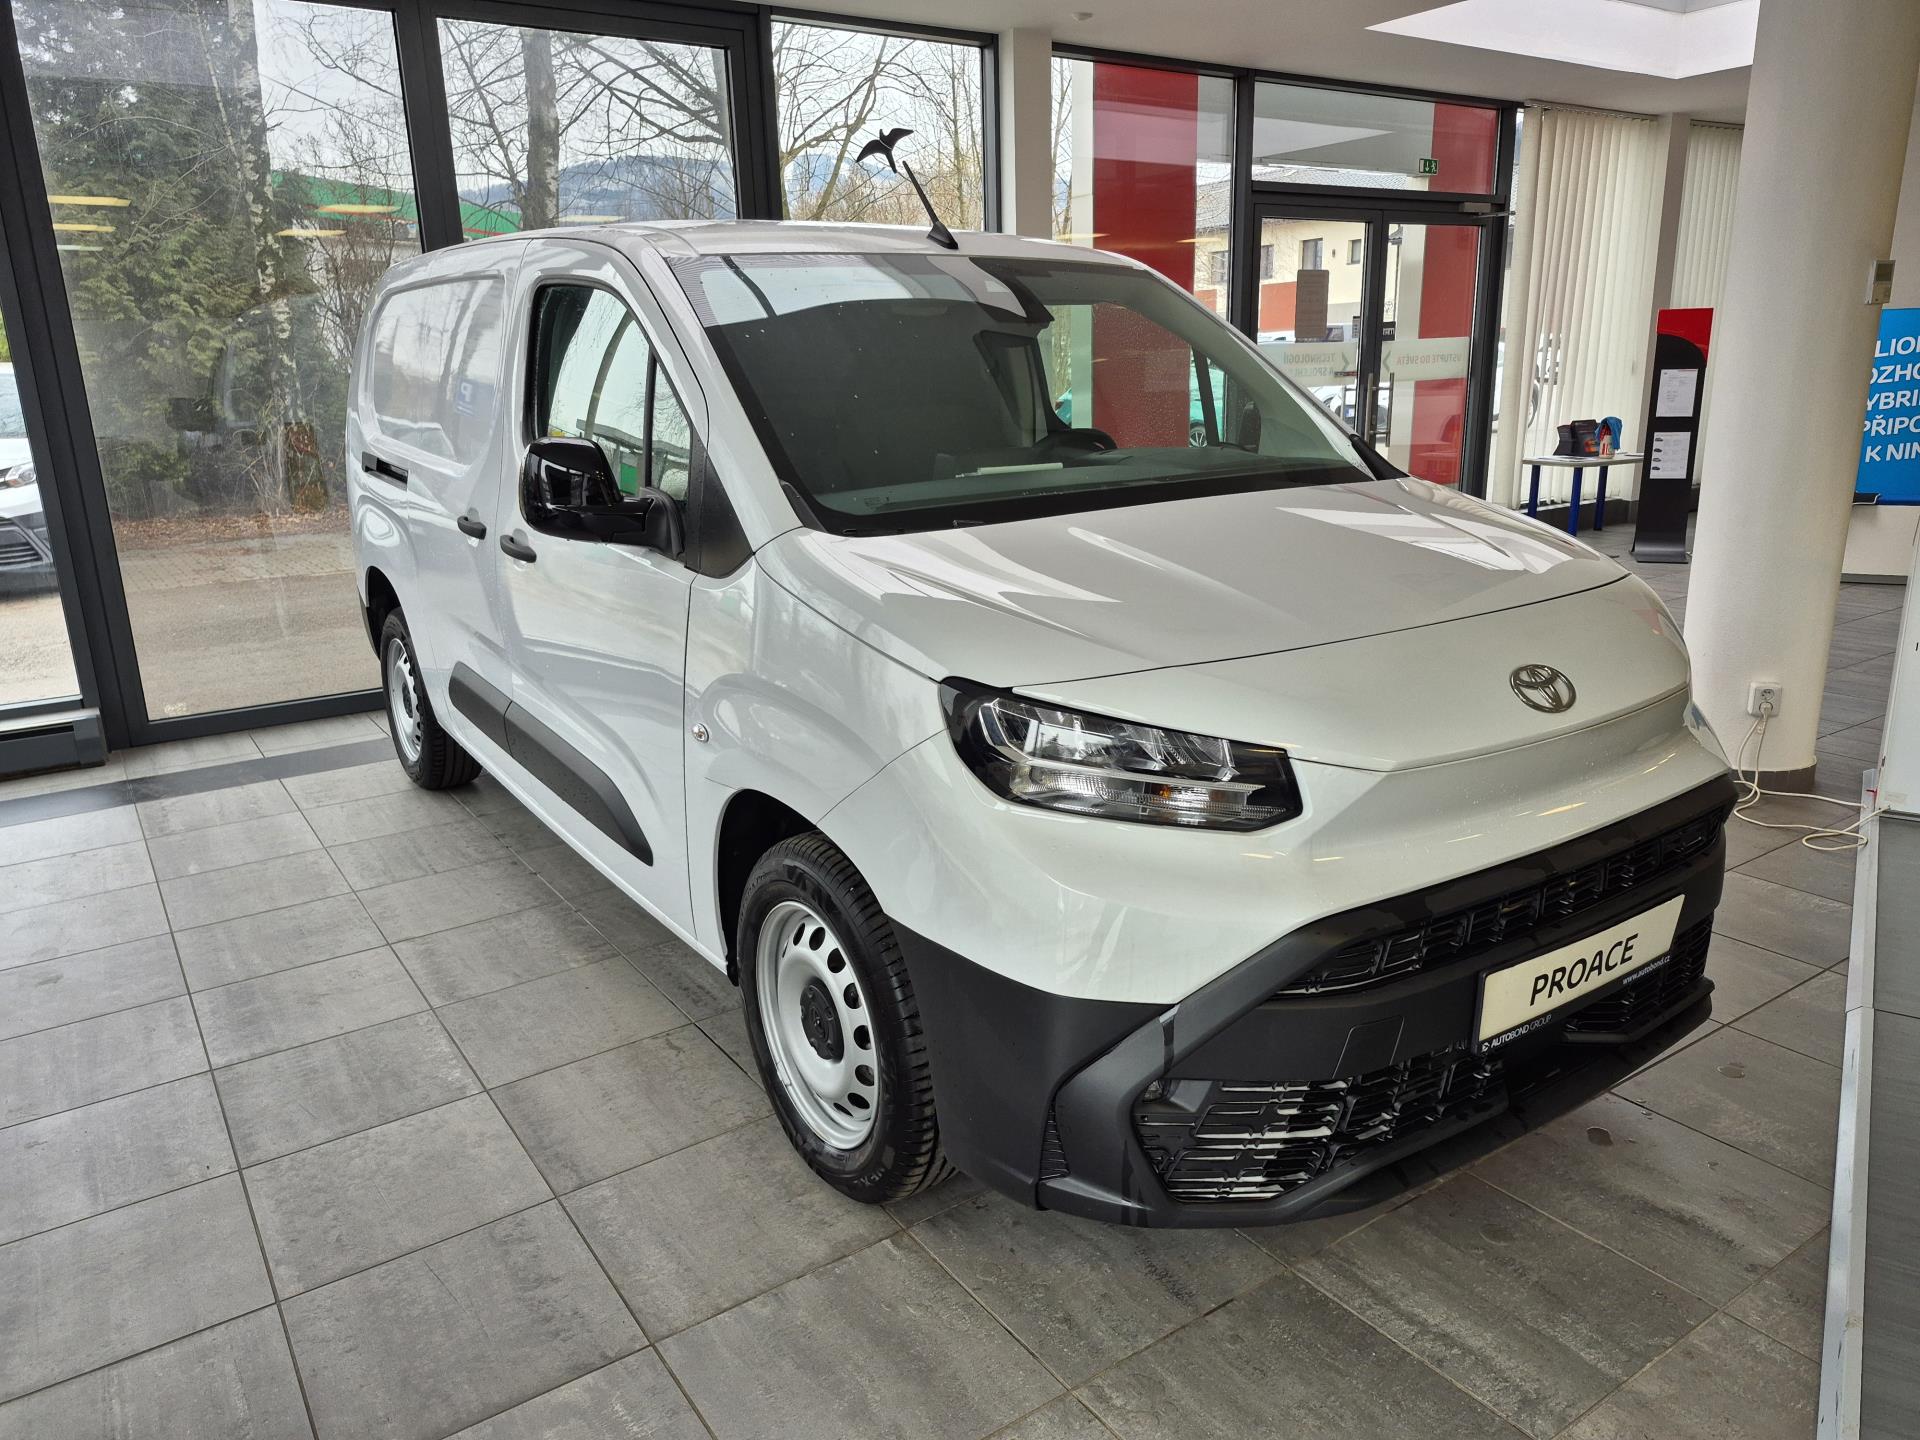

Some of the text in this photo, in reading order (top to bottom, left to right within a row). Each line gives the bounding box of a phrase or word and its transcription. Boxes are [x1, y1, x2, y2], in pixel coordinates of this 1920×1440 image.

[1867, 389, 1920, 411] YBRI
[1864, 445, 1882, 463] K
[1530, 933, 1638, 1006] PROACE
[1622, 955, 1671, 985] www.autobond.cz
[1491, 1014, 1552, 1048] AUTOBOND GROUP
